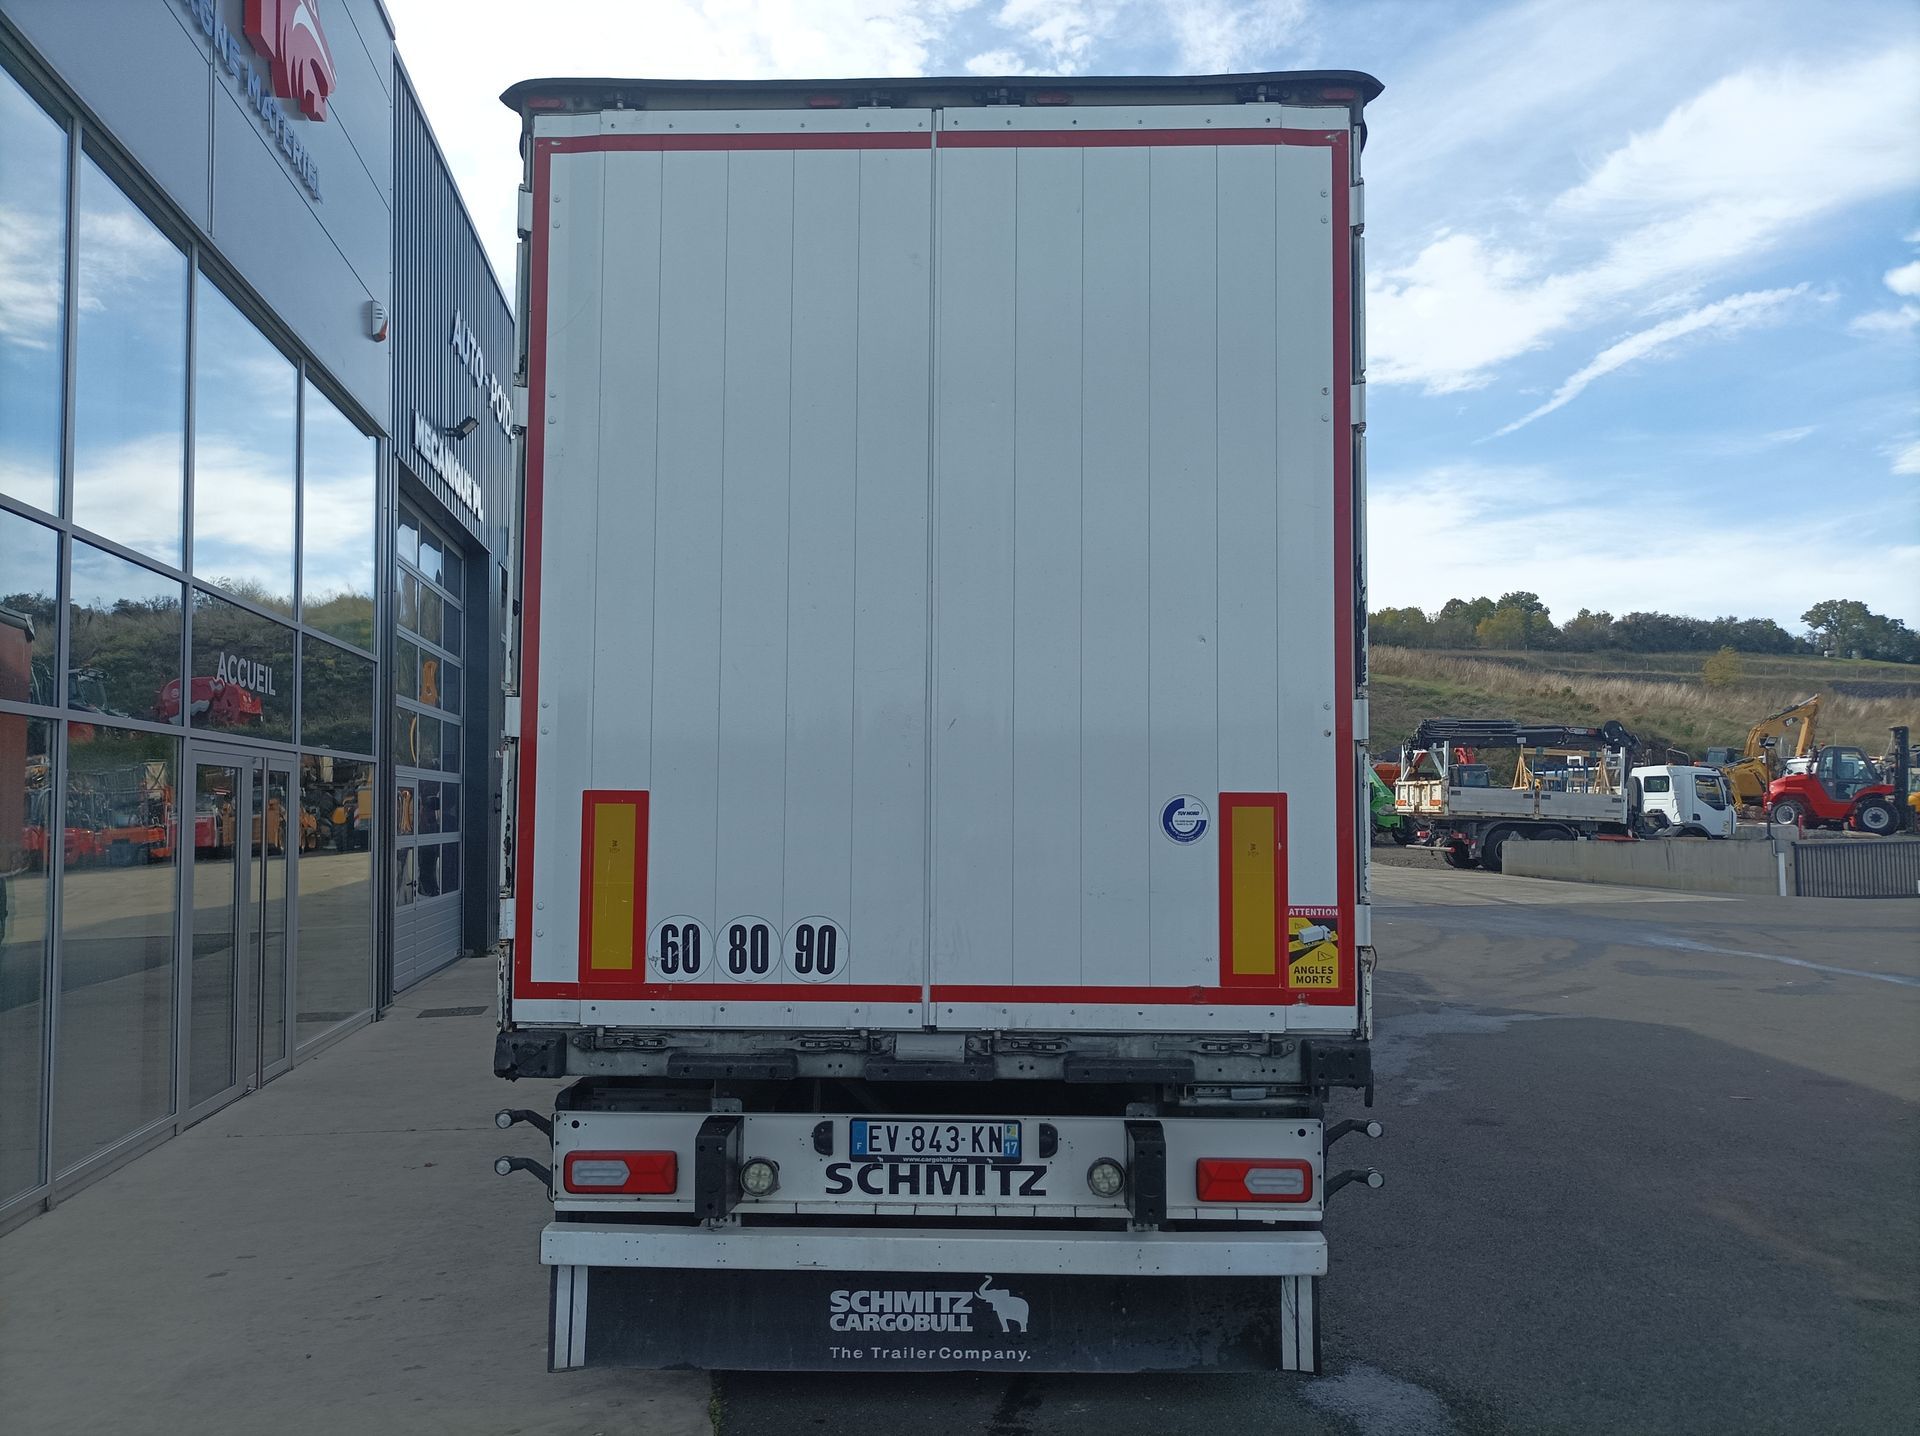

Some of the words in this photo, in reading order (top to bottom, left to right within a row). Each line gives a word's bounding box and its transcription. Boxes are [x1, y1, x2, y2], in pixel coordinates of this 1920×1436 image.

[217, 650, 276, 697] ACCUEIL
[1288, 908, 1338, 916] ATTENTION
[660, 923, 701, 975] 60
[728, 923, 769, 975] 80
[794, 923, 837, 975] 90
[1293, 965, 1334, 975] ANGLES
[1295, 975, 1333, 984] MORTS
[857, 1142, 862, 1151] F
[868, 1125, 1002, 1153] EV-843-KN
[1005, 1141, 1018, 1155] 17
[903, 1156, 968, 1164] www.cargobull.com
[825, 1162, 1048, 1197] SCHMITZ
[829, 1290, 974, 1313] SCHMITZ
[829, 1313, 974, 1332] CARGOBULL
[829, 1346, 863, 1360] The
